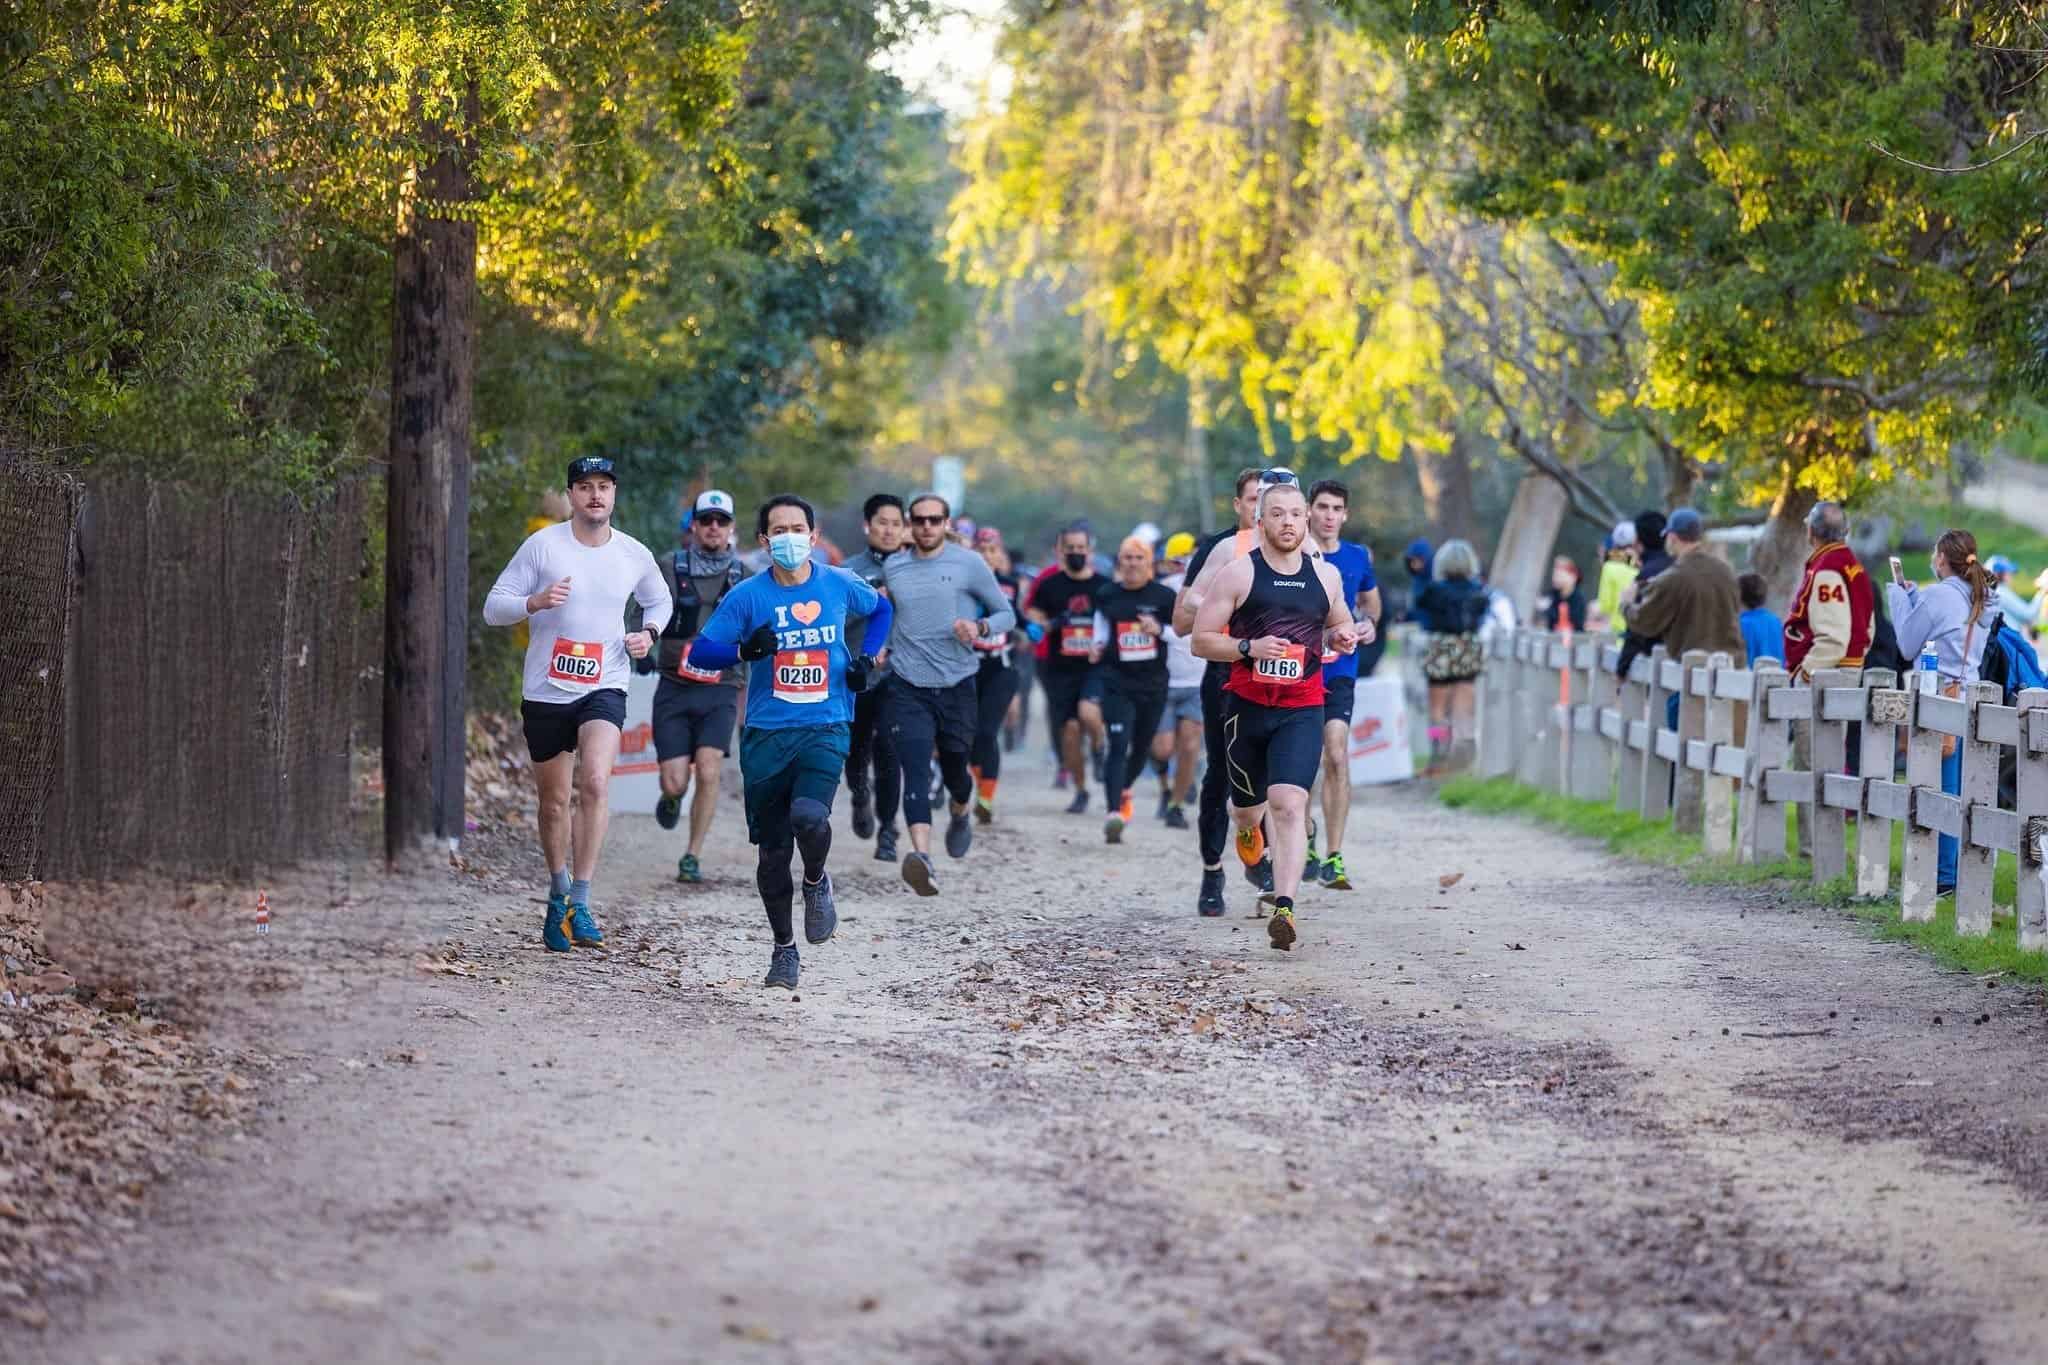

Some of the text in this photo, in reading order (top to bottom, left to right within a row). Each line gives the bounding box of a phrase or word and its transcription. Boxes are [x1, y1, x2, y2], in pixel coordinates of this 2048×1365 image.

[1273, 580, 1306, 589] saucony
[1818, 583, 1845, 603] 64
[774, 606, 790, 628] I
[557, 655, 596, 676] 0062
[1259, 660, 1298, 677] 0168
[780, 667, 822, 684] 0280
